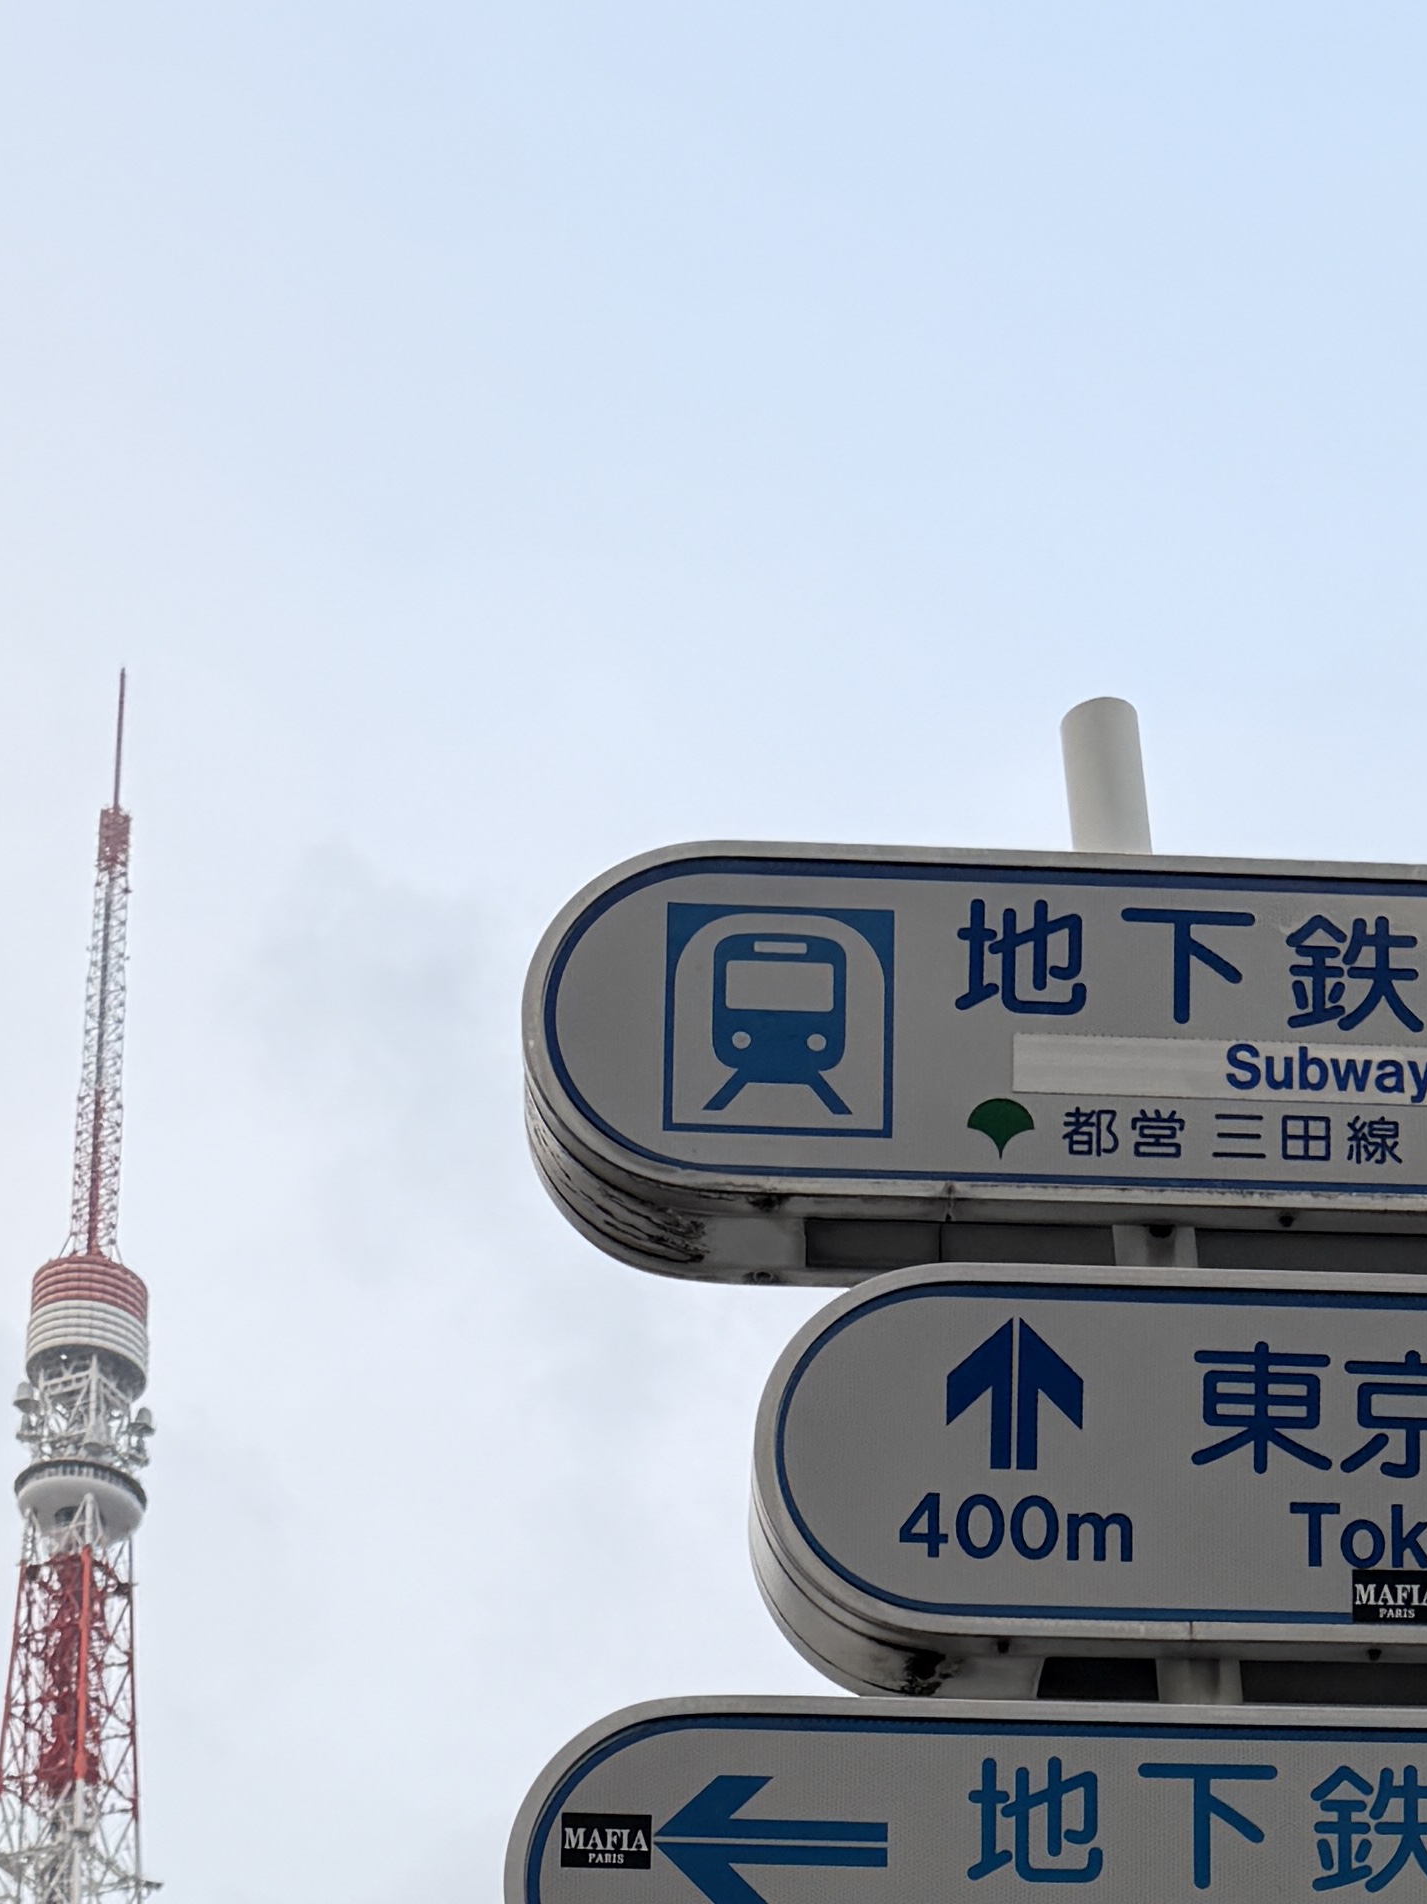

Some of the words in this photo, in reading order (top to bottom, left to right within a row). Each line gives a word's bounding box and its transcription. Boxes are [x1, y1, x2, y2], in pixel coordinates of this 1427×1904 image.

[1062, 1104, 1403, 1165] 都営三田線
[899, 1493, 1133, 1562] 400m
[1379, 1607, 1416, 1619] PARIS
[564, 1827, 649, 1851] MAFIA
[588, 1853, 625, 1864] PARIS
